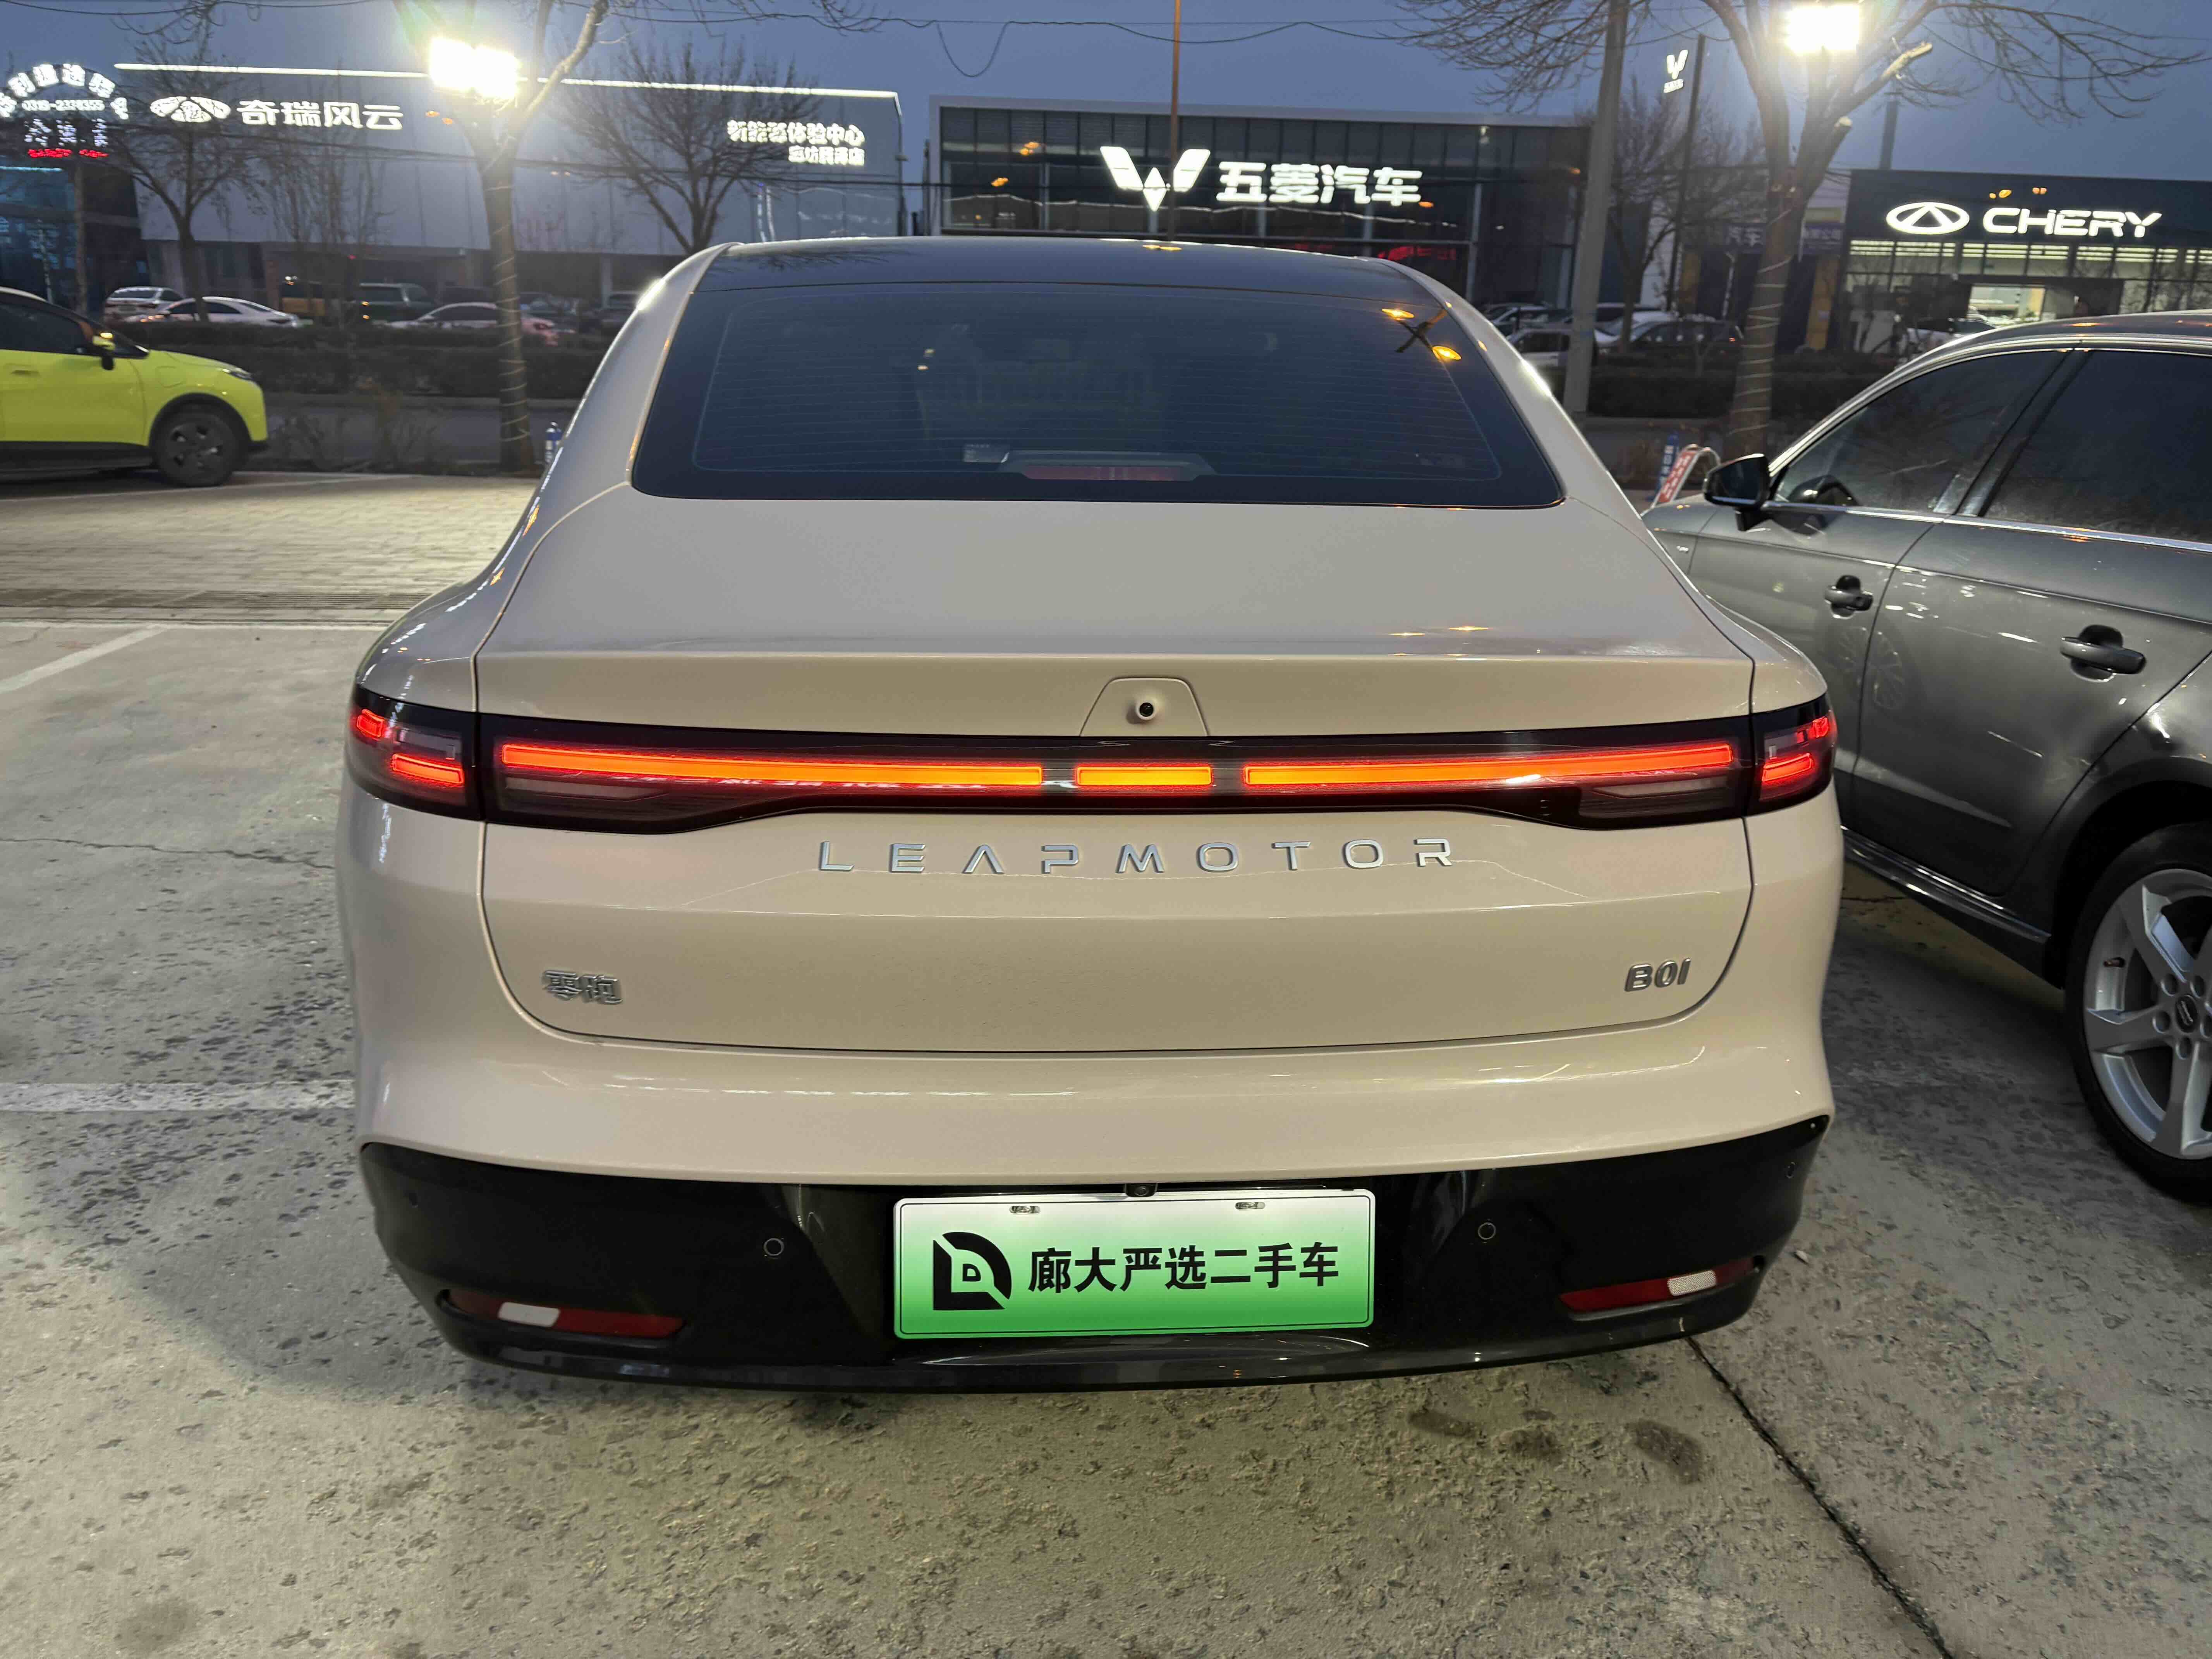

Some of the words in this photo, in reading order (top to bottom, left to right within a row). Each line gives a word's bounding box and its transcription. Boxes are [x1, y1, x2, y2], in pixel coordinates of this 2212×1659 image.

[237, 100, 403, 130] 奇瑞风云
[1216, 161, 1423, 206] 五菱汽车
[1983, 207, 2162, 237] CHERY
[819, 838, 1453, 874] LEAPMOTOR
[543, 970, 623, 1005] 零跑
[1028, 1241, 1339, 1293] 廊大严选二手车
